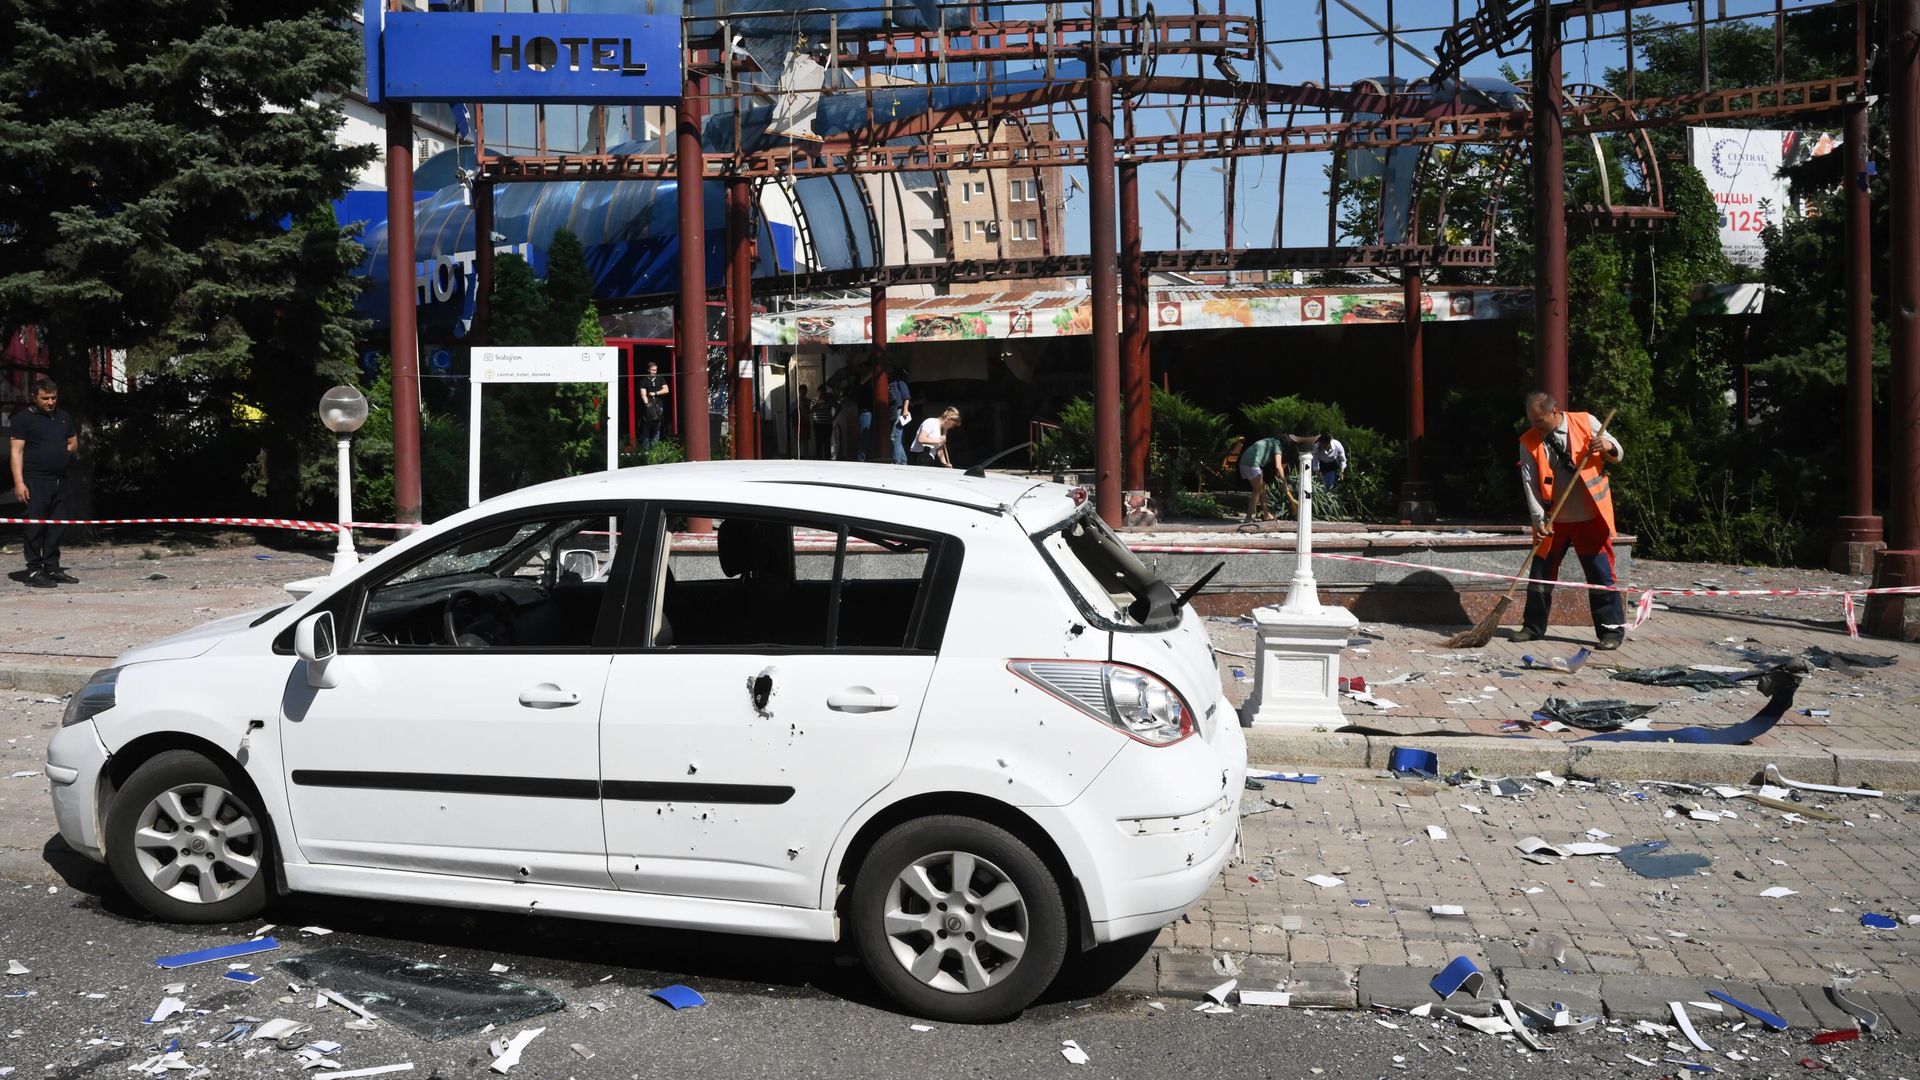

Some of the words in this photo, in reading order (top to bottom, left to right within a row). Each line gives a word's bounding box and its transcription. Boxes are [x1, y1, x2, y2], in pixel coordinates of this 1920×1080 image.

[491, 35, 648, 76] HOTEL
[1727, 153, 1766, 162] CENTRAL
[1729, 210, 1764, 232] 125
[415, 242, 534, 306] HOT
[495, 353, 523, 363] Instagram
